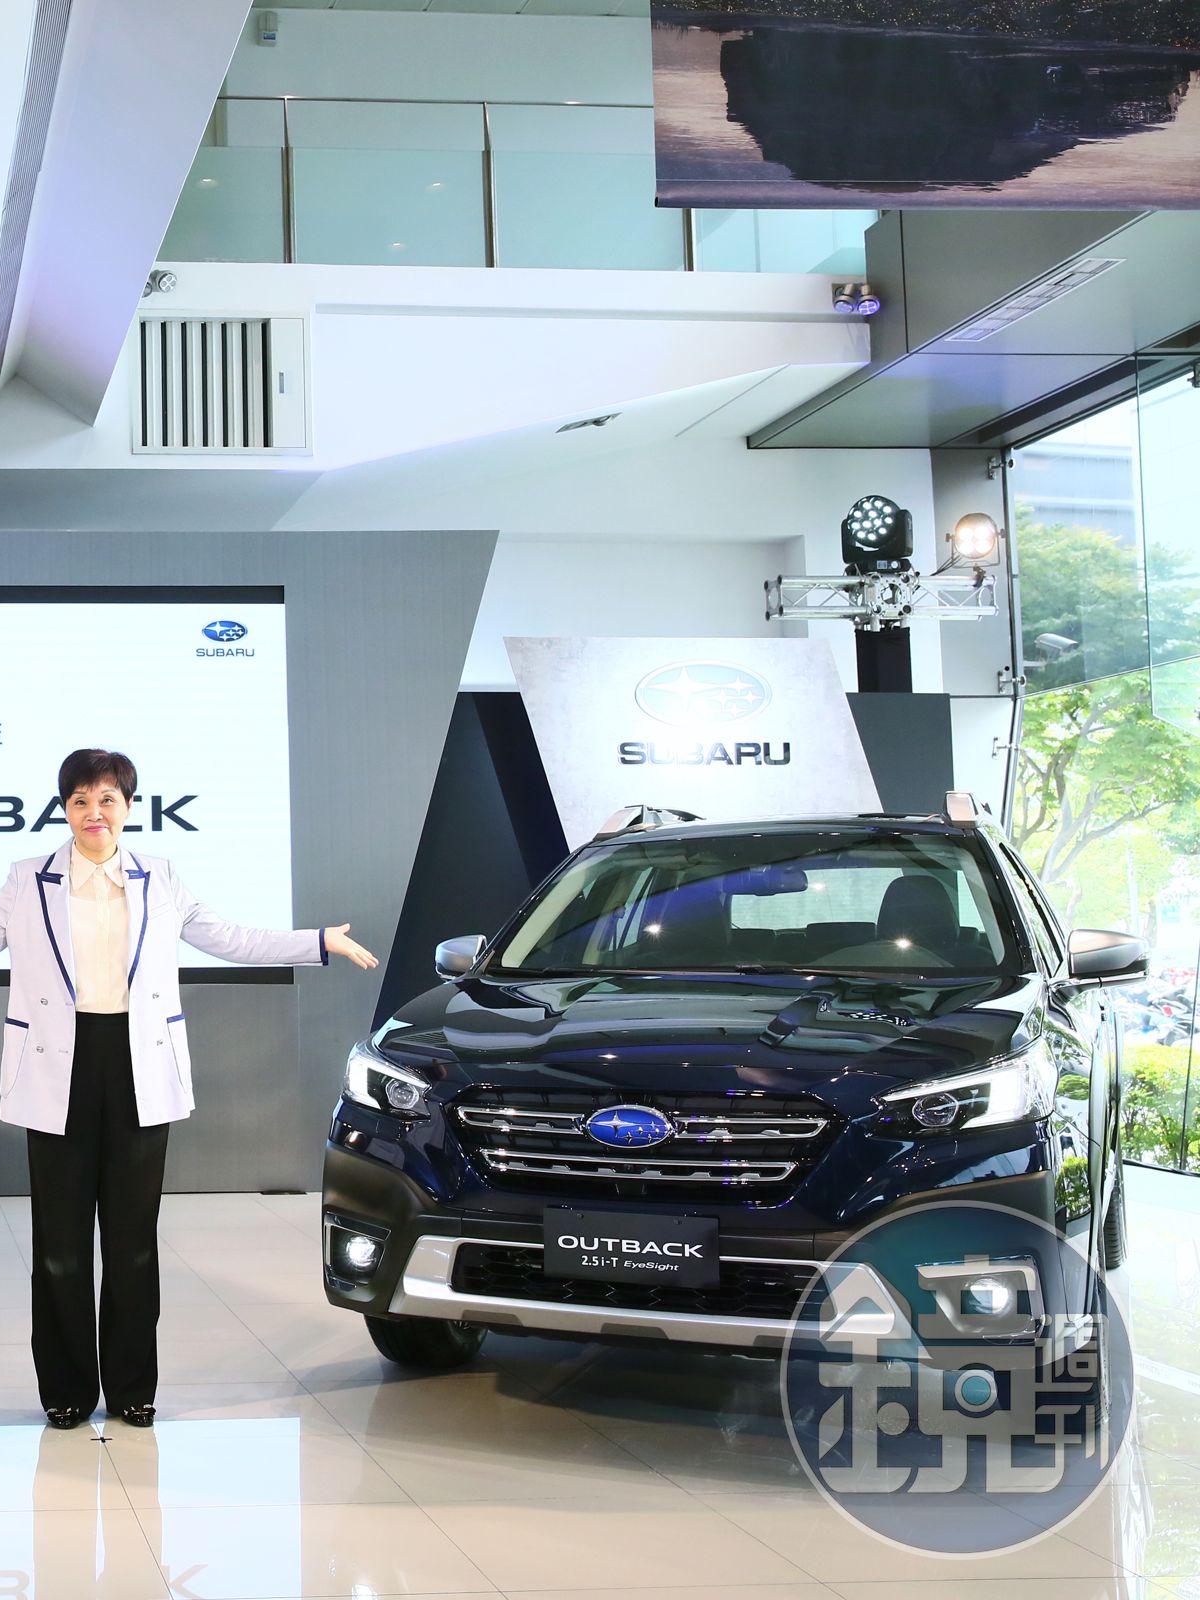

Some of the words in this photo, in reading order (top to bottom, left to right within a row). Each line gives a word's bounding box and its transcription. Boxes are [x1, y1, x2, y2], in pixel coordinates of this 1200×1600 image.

[196, 648, 255, 657] SUBARU
[618, 742, 790, 765] SUBARU
[557, 1235, 703, 1258] OUTBACK
[623, 1260, 679, 1271] EyeSight
